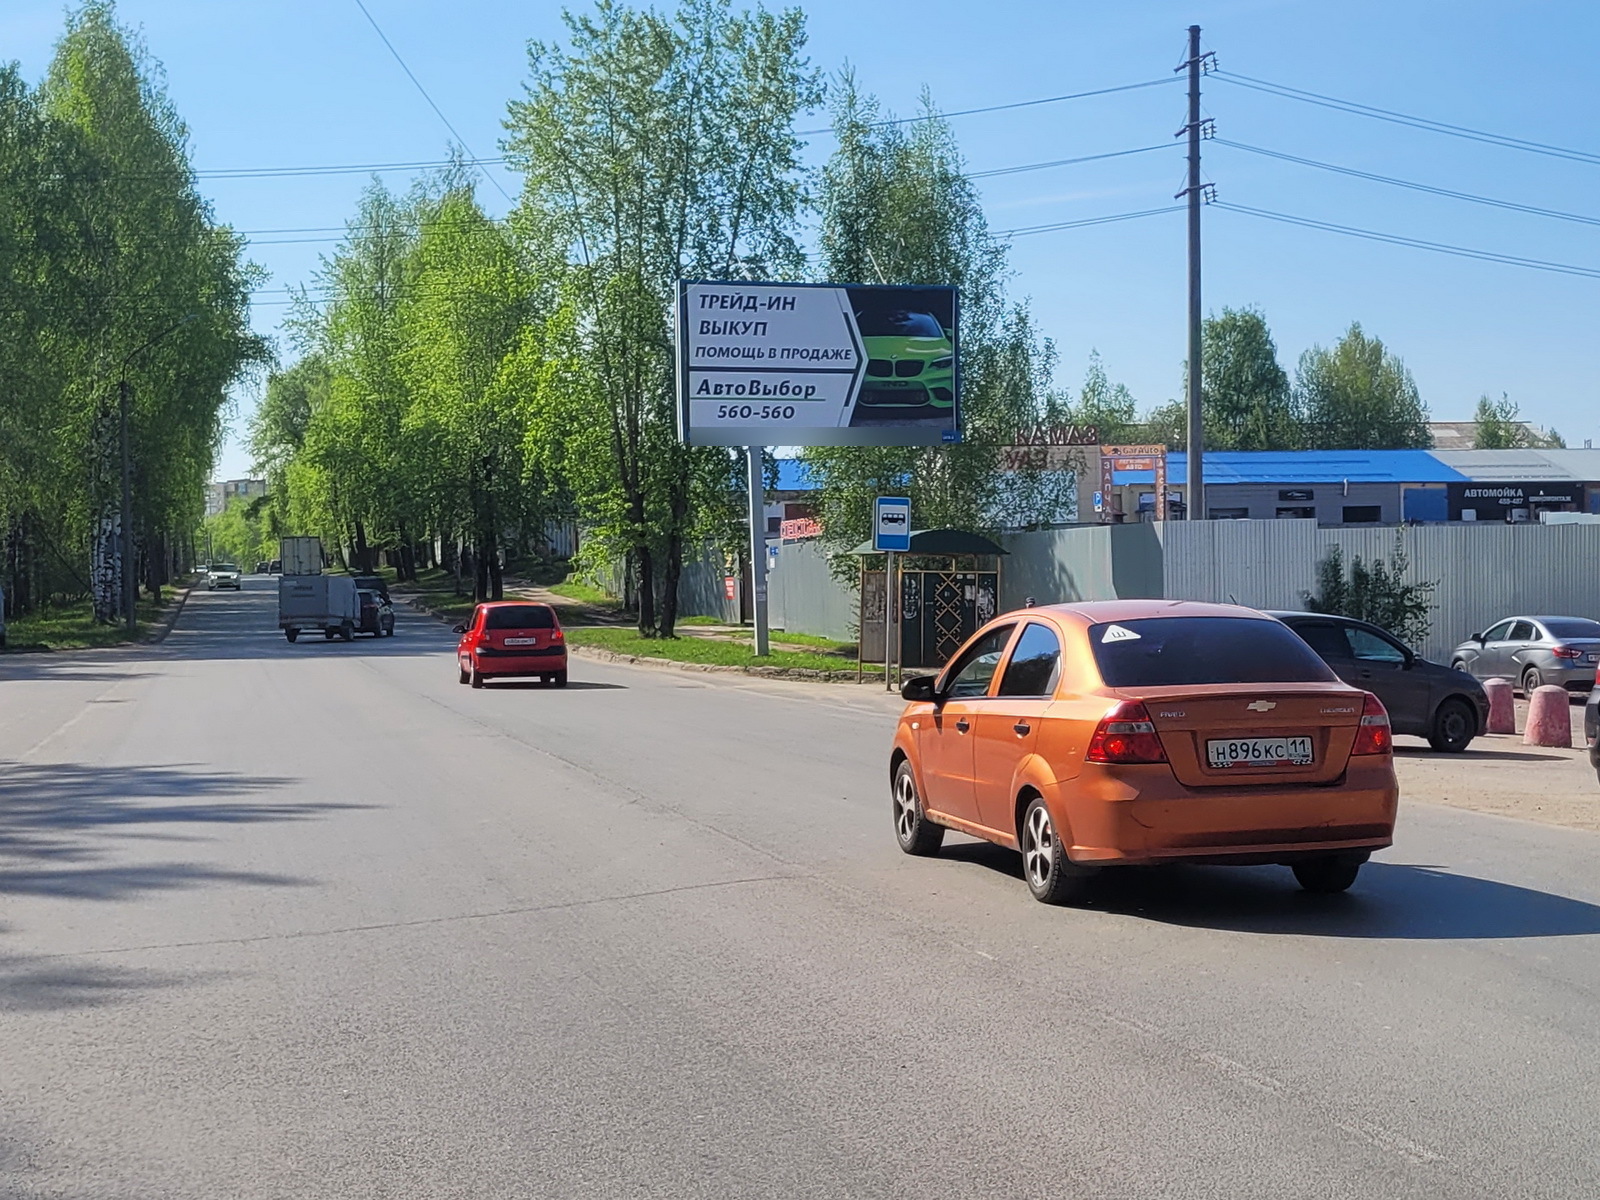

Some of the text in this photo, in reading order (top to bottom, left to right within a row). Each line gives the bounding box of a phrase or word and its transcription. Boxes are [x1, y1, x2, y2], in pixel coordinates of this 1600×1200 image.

[699, 292, 797, 312] ТРЕЙД-ИН
[699, 320, 768, 336] ВЫКУП
[695, 346, 852, 361] ПОМОЩЬ В ПРОДАЖЕ
[717, 405, 796, 419] 560-560
[1015, 424, 1097, 445] КАМАЗ
[1464, 486, 1524, 498] АВТОМОЙКА
[1290, 739, 1307, 753] 11
